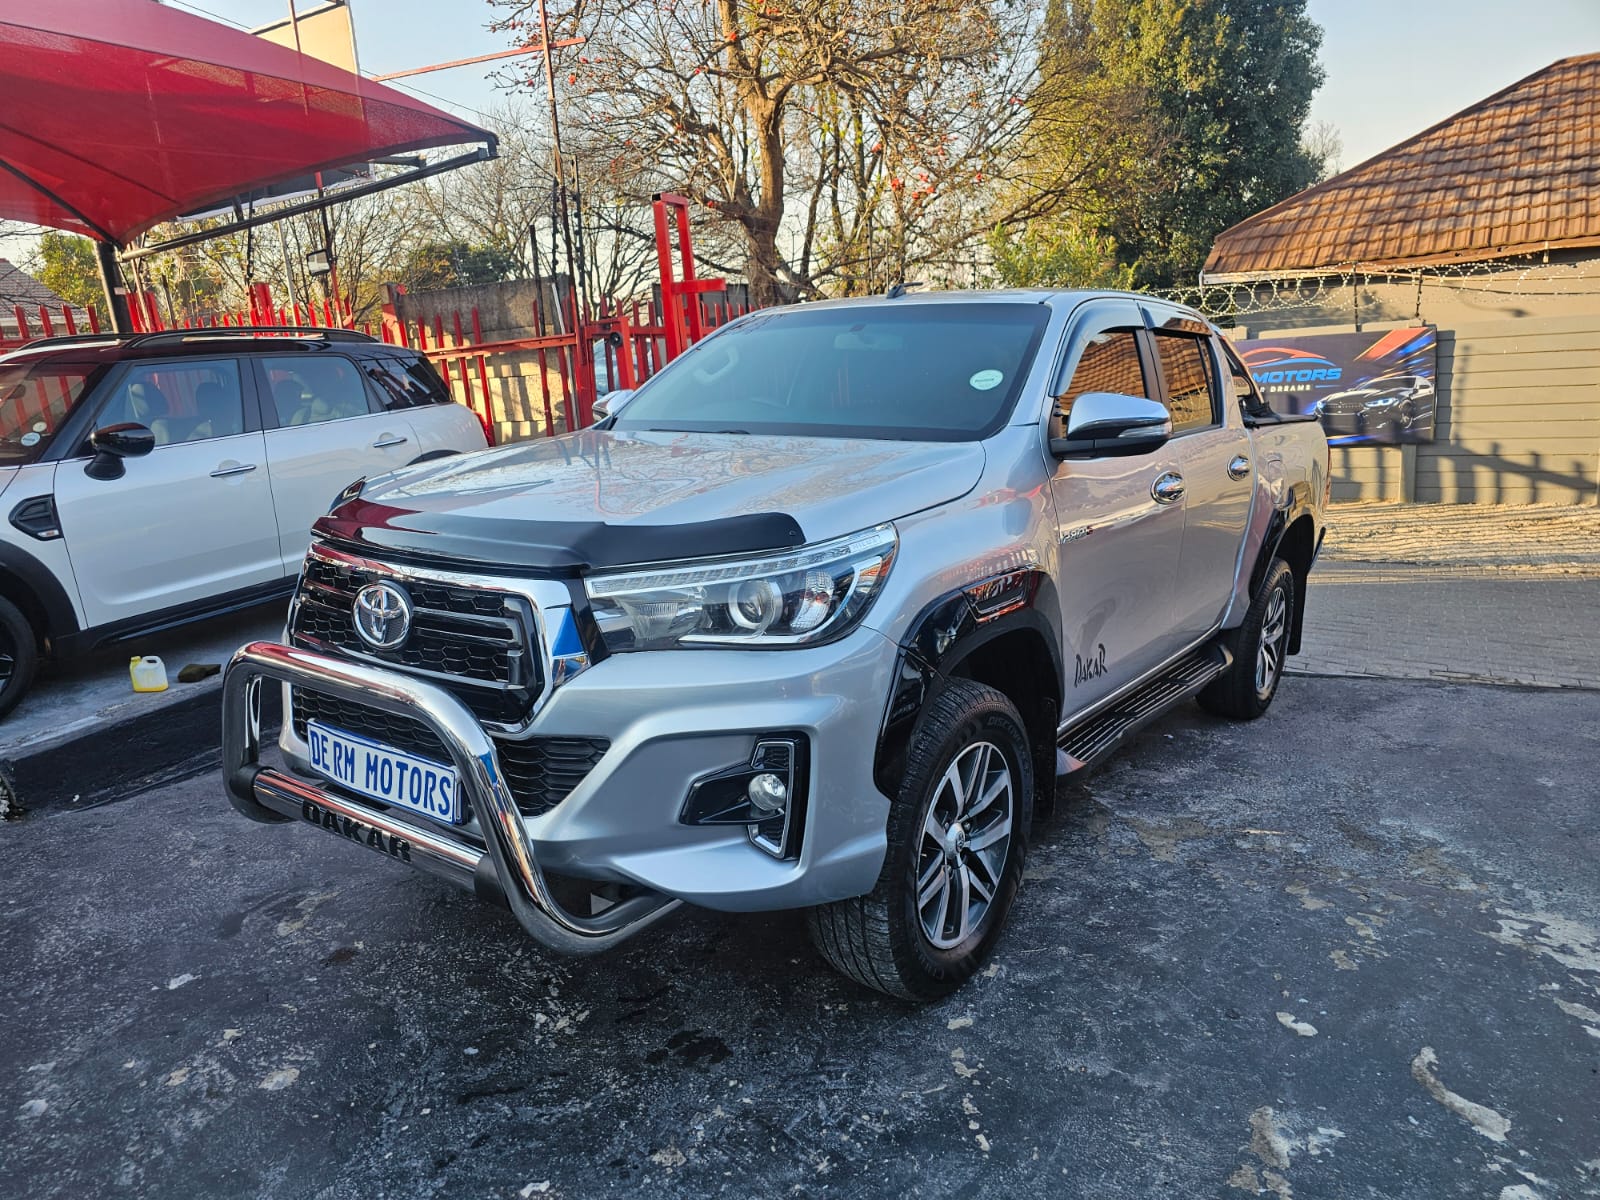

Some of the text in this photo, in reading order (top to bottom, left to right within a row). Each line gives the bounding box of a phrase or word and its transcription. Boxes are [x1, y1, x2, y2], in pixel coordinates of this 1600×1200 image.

[1252, 368, 1343, 383] MOTORS
[1270, 384, 1311, 393] DREAMS
[1074, 643, 1108, 688] DAKAR
[309, 730, 452, 816] DERM MOTORS
[302, 800, 412, 863] DAKAR
